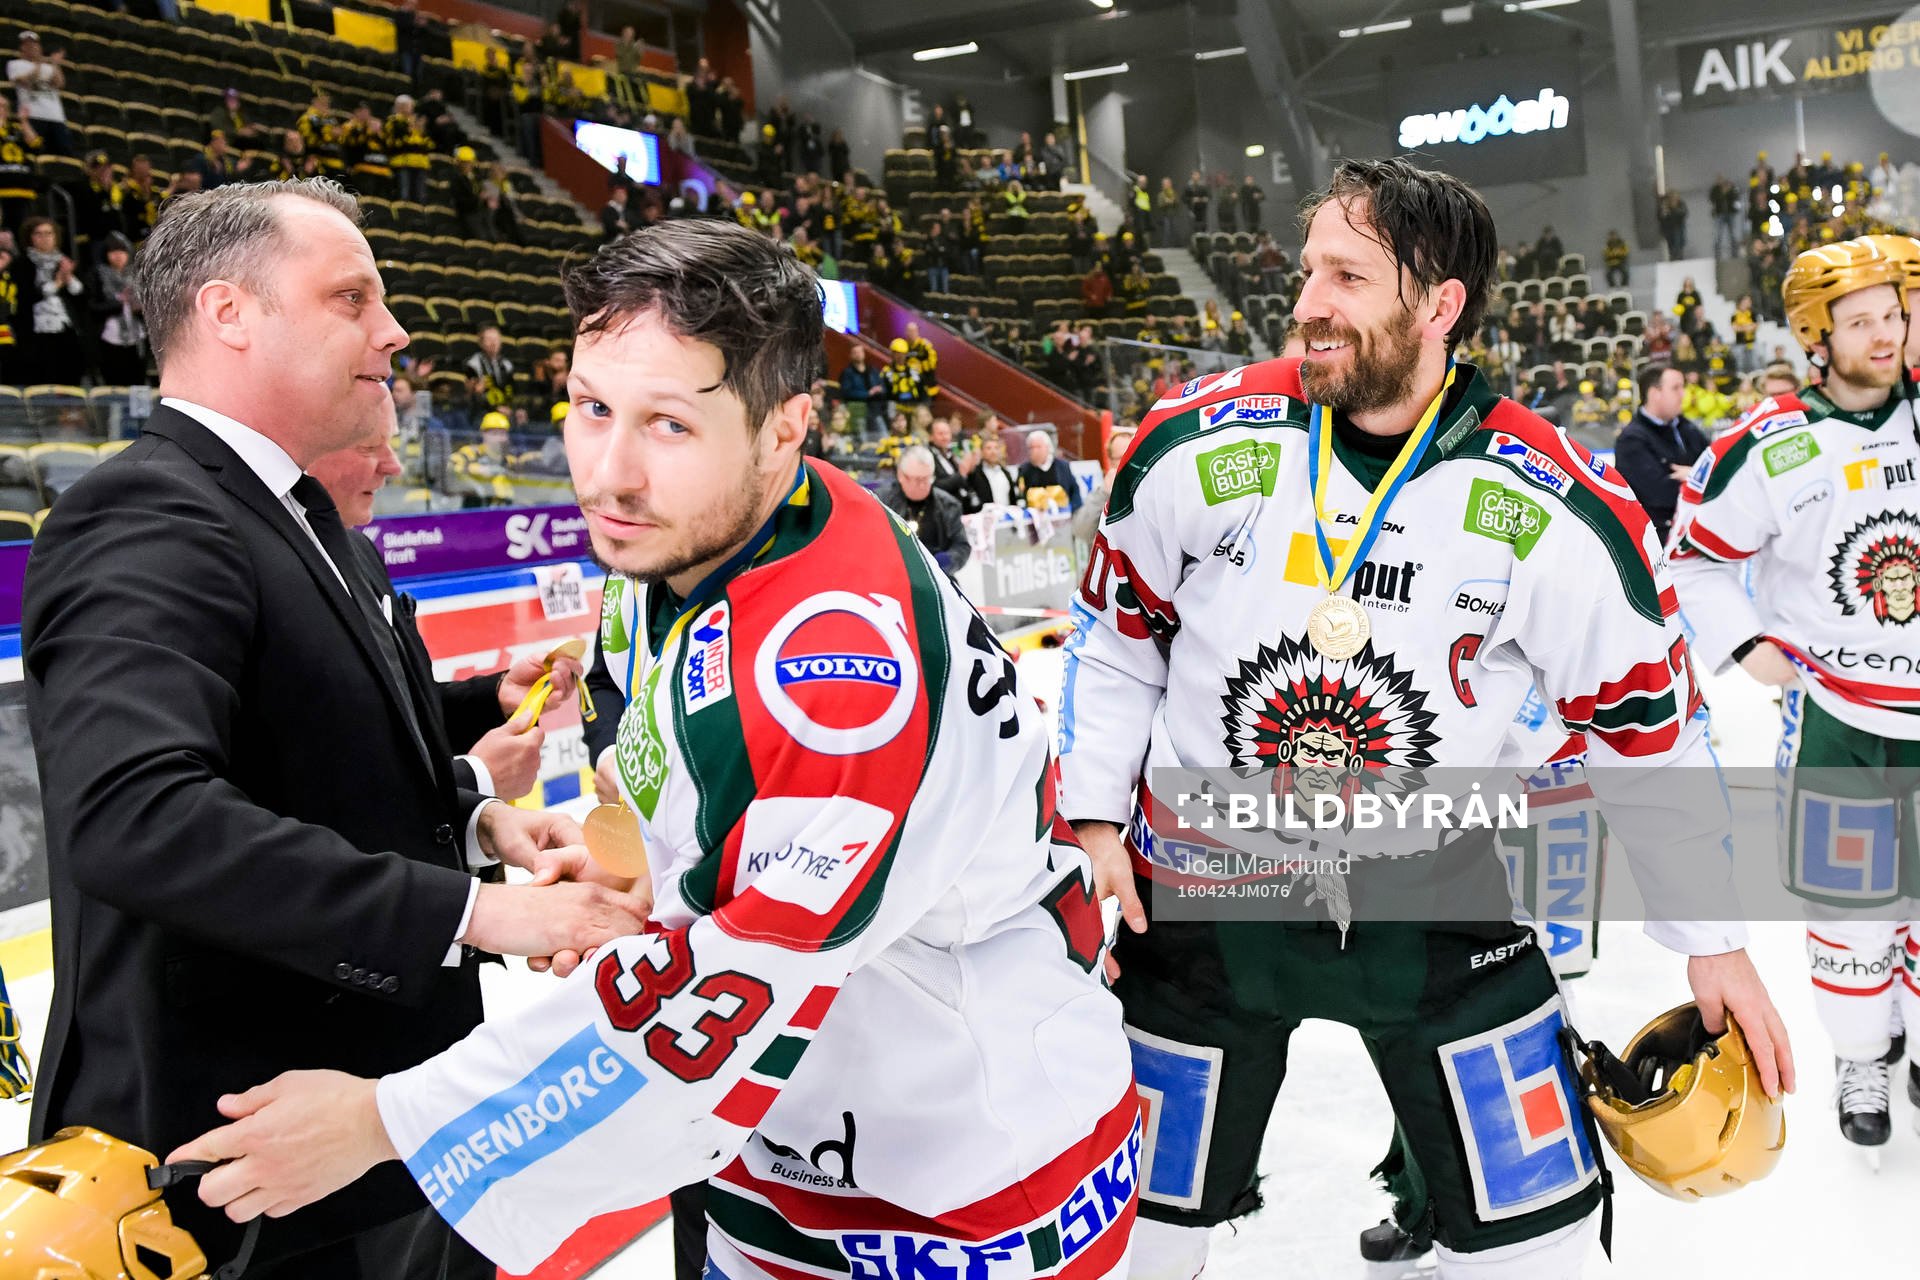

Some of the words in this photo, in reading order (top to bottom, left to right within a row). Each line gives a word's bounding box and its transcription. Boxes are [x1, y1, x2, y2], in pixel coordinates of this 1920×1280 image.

[1835, 28, 1864, 51] VI
[1693, 38, 1796, 95] AIK
[1803, 46, 1904, 82] ALDRIG
[1398, 87, 1570, 148] swoosh
[1235, 408, 1282, 421] SPORT
[1236, 397, 1282, 409] INTER
[1522, 459, 1564, 491] SPORT
[1526, 450, 1567, 484] INTER
[505, 512, 553, 560] SK
[384, 547, 416, 565] Kraft
[1363, 598, 1410, 613] interiör
[689, 650, 707, 701] SPORT
[705, 639, 725, 693] INTER
[781, 657, 897, 681] VOLVO
[1449, 633, 1485, 709] C
[791, 846, 840, 880] TYRE
[595, 926, 773, 1084] 33
[416, 1046, 625, 1211] EHRENBORG
[770, 1161, 835, 1188] Business
[1061, 1113, 1142, 1260] SKF
[841, 1231, 1026, 1280] SKF
